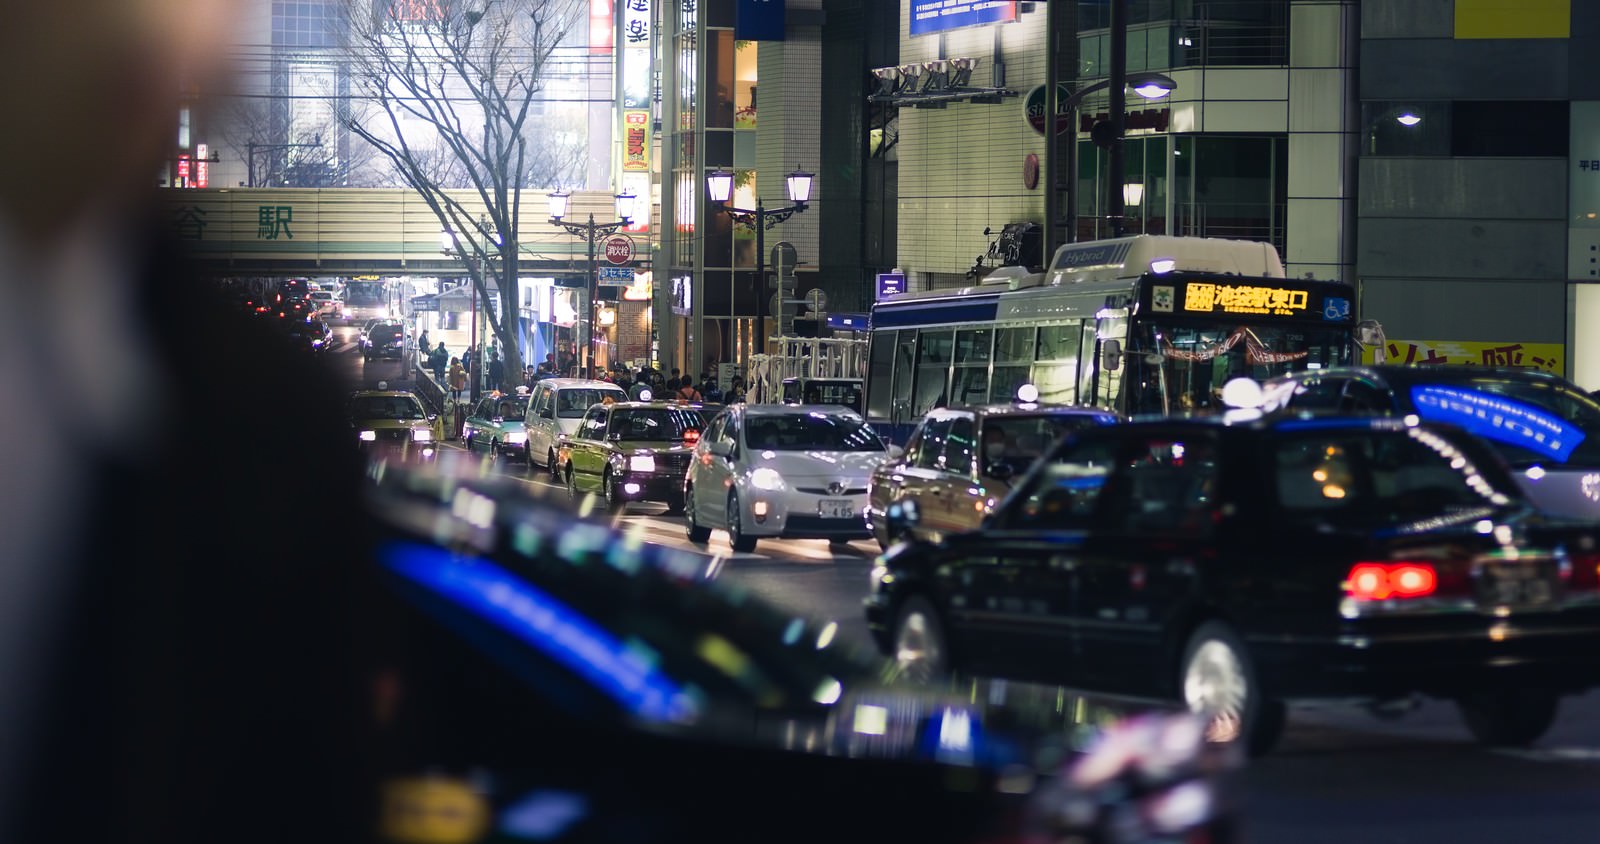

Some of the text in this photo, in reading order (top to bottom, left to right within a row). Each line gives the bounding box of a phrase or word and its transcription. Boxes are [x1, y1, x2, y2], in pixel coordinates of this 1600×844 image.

[607, 245, 629, 256] 消火栓
[1064, 250, 1105, 264] Hybrid
[1213, 285, 1309, 310] 池袋駅東口
